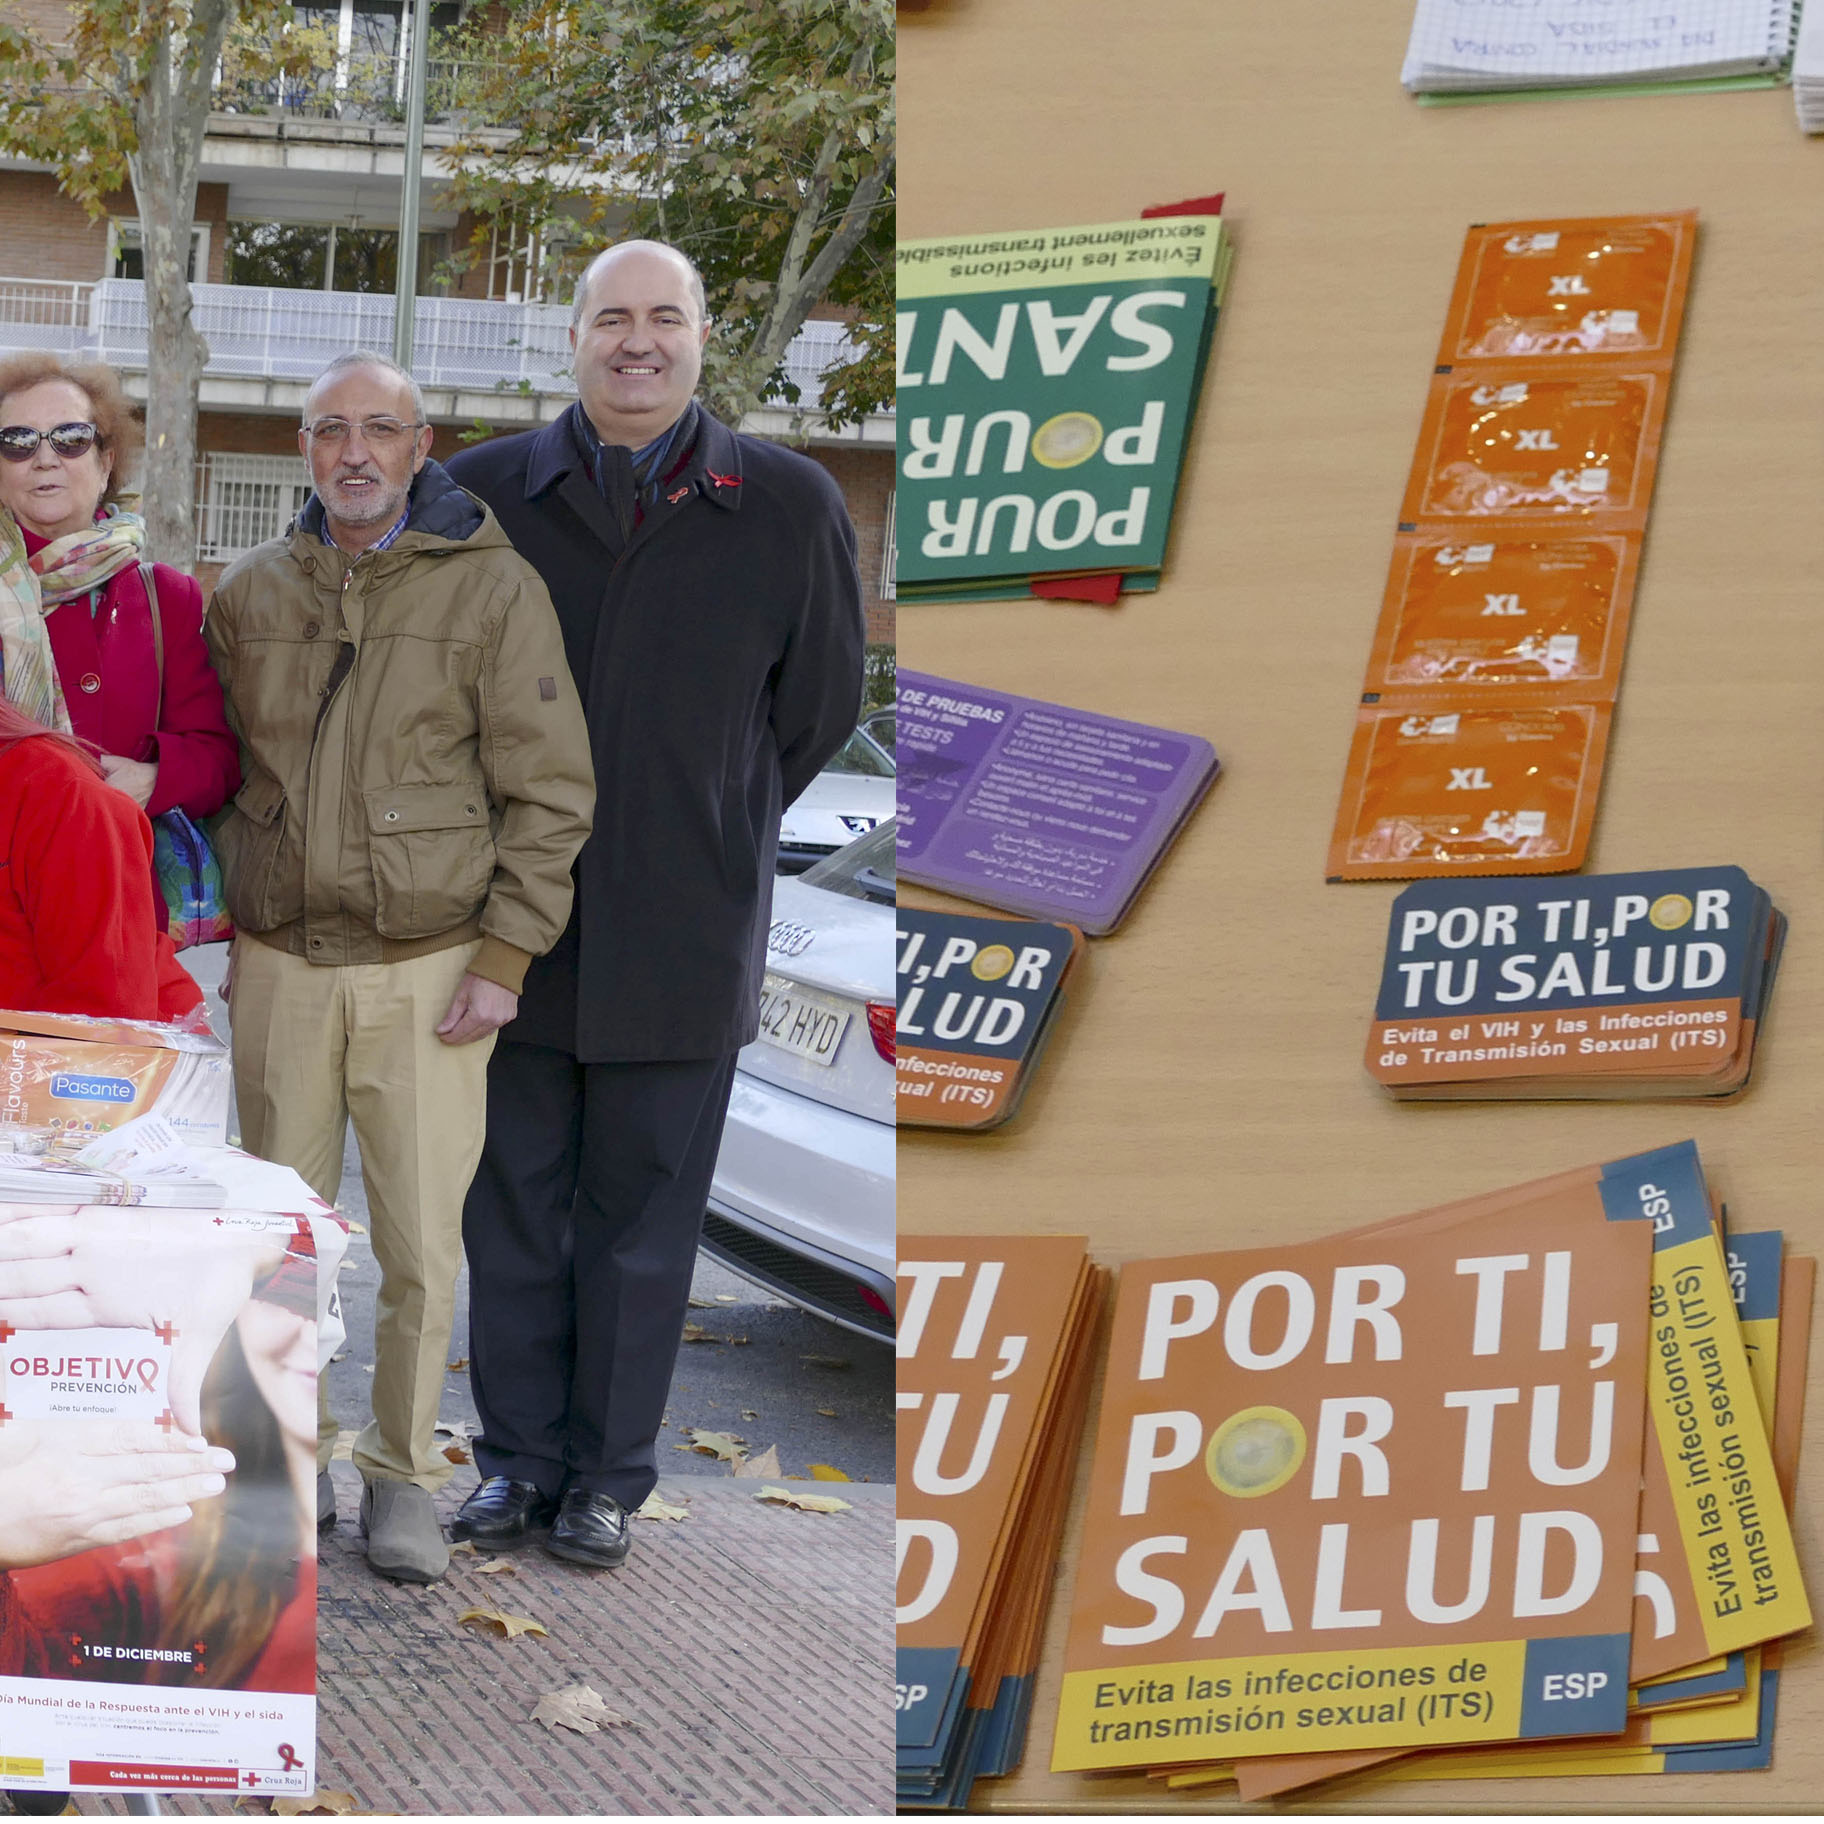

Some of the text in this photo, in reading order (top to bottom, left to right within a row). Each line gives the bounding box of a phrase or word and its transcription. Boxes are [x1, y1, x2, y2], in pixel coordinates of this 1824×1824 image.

[949, 246, 1201, 278] Évitez les infections
[1547, 276, 1591, 297] XL
[921, 486, 1150, 558] POUR
[1400, 904, 1518, 952] POR
[1398, 942, 1727, 1008] TU SALUD
[789, 1005, 838, 1054] HYD
[1380, 1029, 1726, 1067] de Transmisión Sexual (ITS)
[1383, 1009, 1728, 1045] Evita el VIH y las Infecciones
[2, 1039, 26, 1125] Flavours
[56, 1077, 130, 1098] Pasante
[1137, 1251, 1620, 1382] POR TI,
[1443, 1380, 1615, 1494] TU
[1100, 1509, 1606, 1649] SALUD
[1094, 1658, 1487, 1708] Evita las infecciones de
[1542, 1672, 1608, 1701] ESP
[1089, 1690, 1494, 1744] transmisión sexual (ITS)
